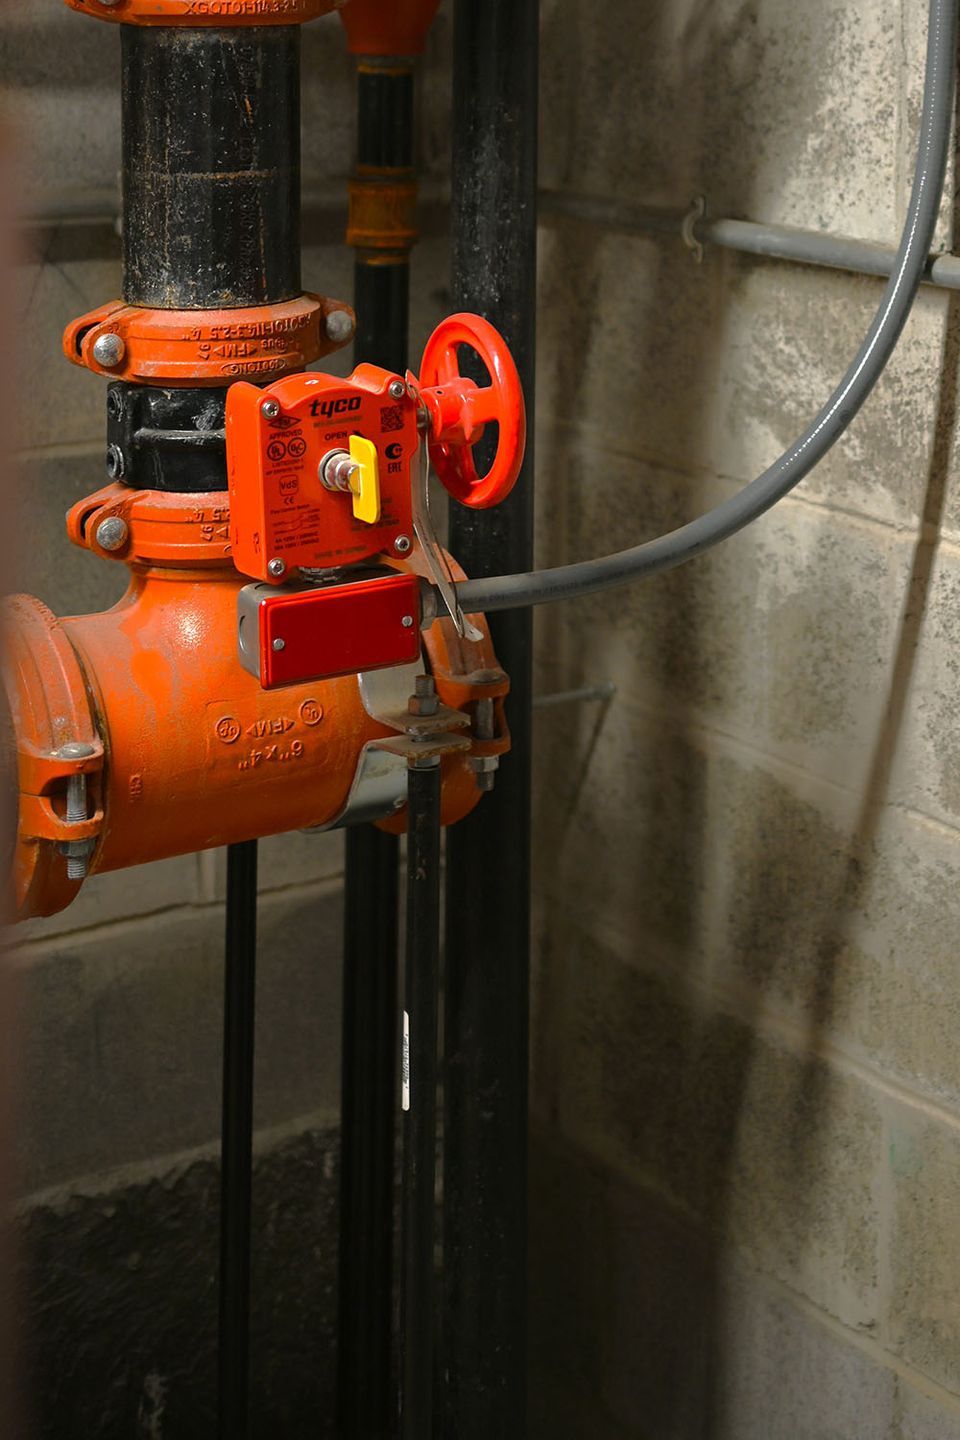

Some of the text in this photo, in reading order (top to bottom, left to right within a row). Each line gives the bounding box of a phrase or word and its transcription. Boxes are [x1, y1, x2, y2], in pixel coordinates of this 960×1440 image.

[309, 397, 361, 418] tyco
[269, 428, 303, 441] APPROVED
[324, 430, 348, 442] OPEN
[280, 479, 298, 491] VdS
